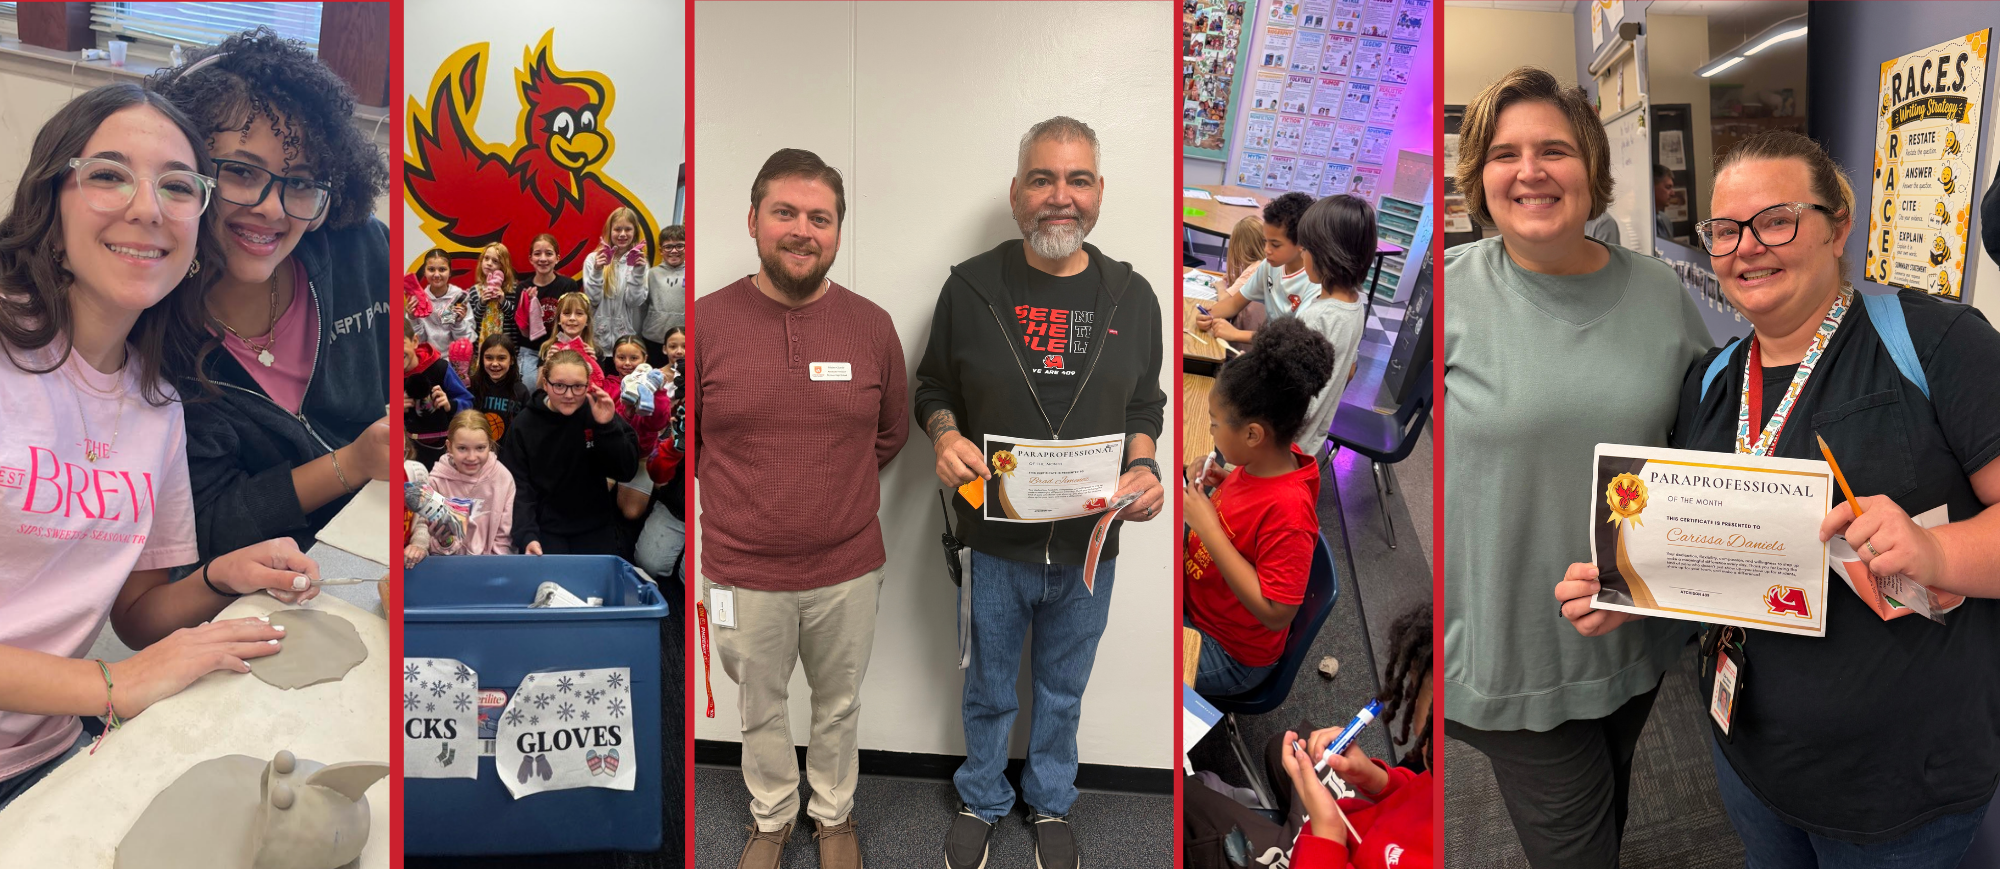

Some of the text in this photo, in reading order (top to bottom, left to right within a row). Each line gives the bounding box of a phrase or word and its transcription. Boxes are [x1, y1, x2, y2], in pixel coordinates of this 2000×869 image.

[1892, 52, 1967, 107] R.A.C.E.S.
[1900, 98, 1958, 121] Writing Strategy
[1908, 131, 1936, 146] RESTATE
[1905, 167, 1932, 179] ANSWER
[1902, 200, 1917, 212] CITE
[1899, 231, 1924, 243] EXPLAIN
[1894, 262, 1927, 273] SUMMARY STATEMENT
[1014, 304, 1070, 323] SEE
[1018, 320, 1069, 338] HE
[84, 438, 110, 458] THE
[1018, 448, 1114, 458] PARAPROFESSIONAL
[1650, 472, 1814, 498] PARAPROFESSIONAL
[1680, 496, 1694, 504] THE
[1696, 498, 1723, 507] MONTH
[1680, 517, 1714, 525] CERTIFICATE
[1722, 521, 1751, 529] PRESENTED
[44, 528, 80, 541] SWEETS
[90, 529, 130, 544] SEASONAL
[1666, 528, 1785, 551] Carissa Daniels
[1194, 552, 1209, 569] ROCK
[405, 718, 457, 740] CKS
[516, 725, 622, 754] GLOVES
